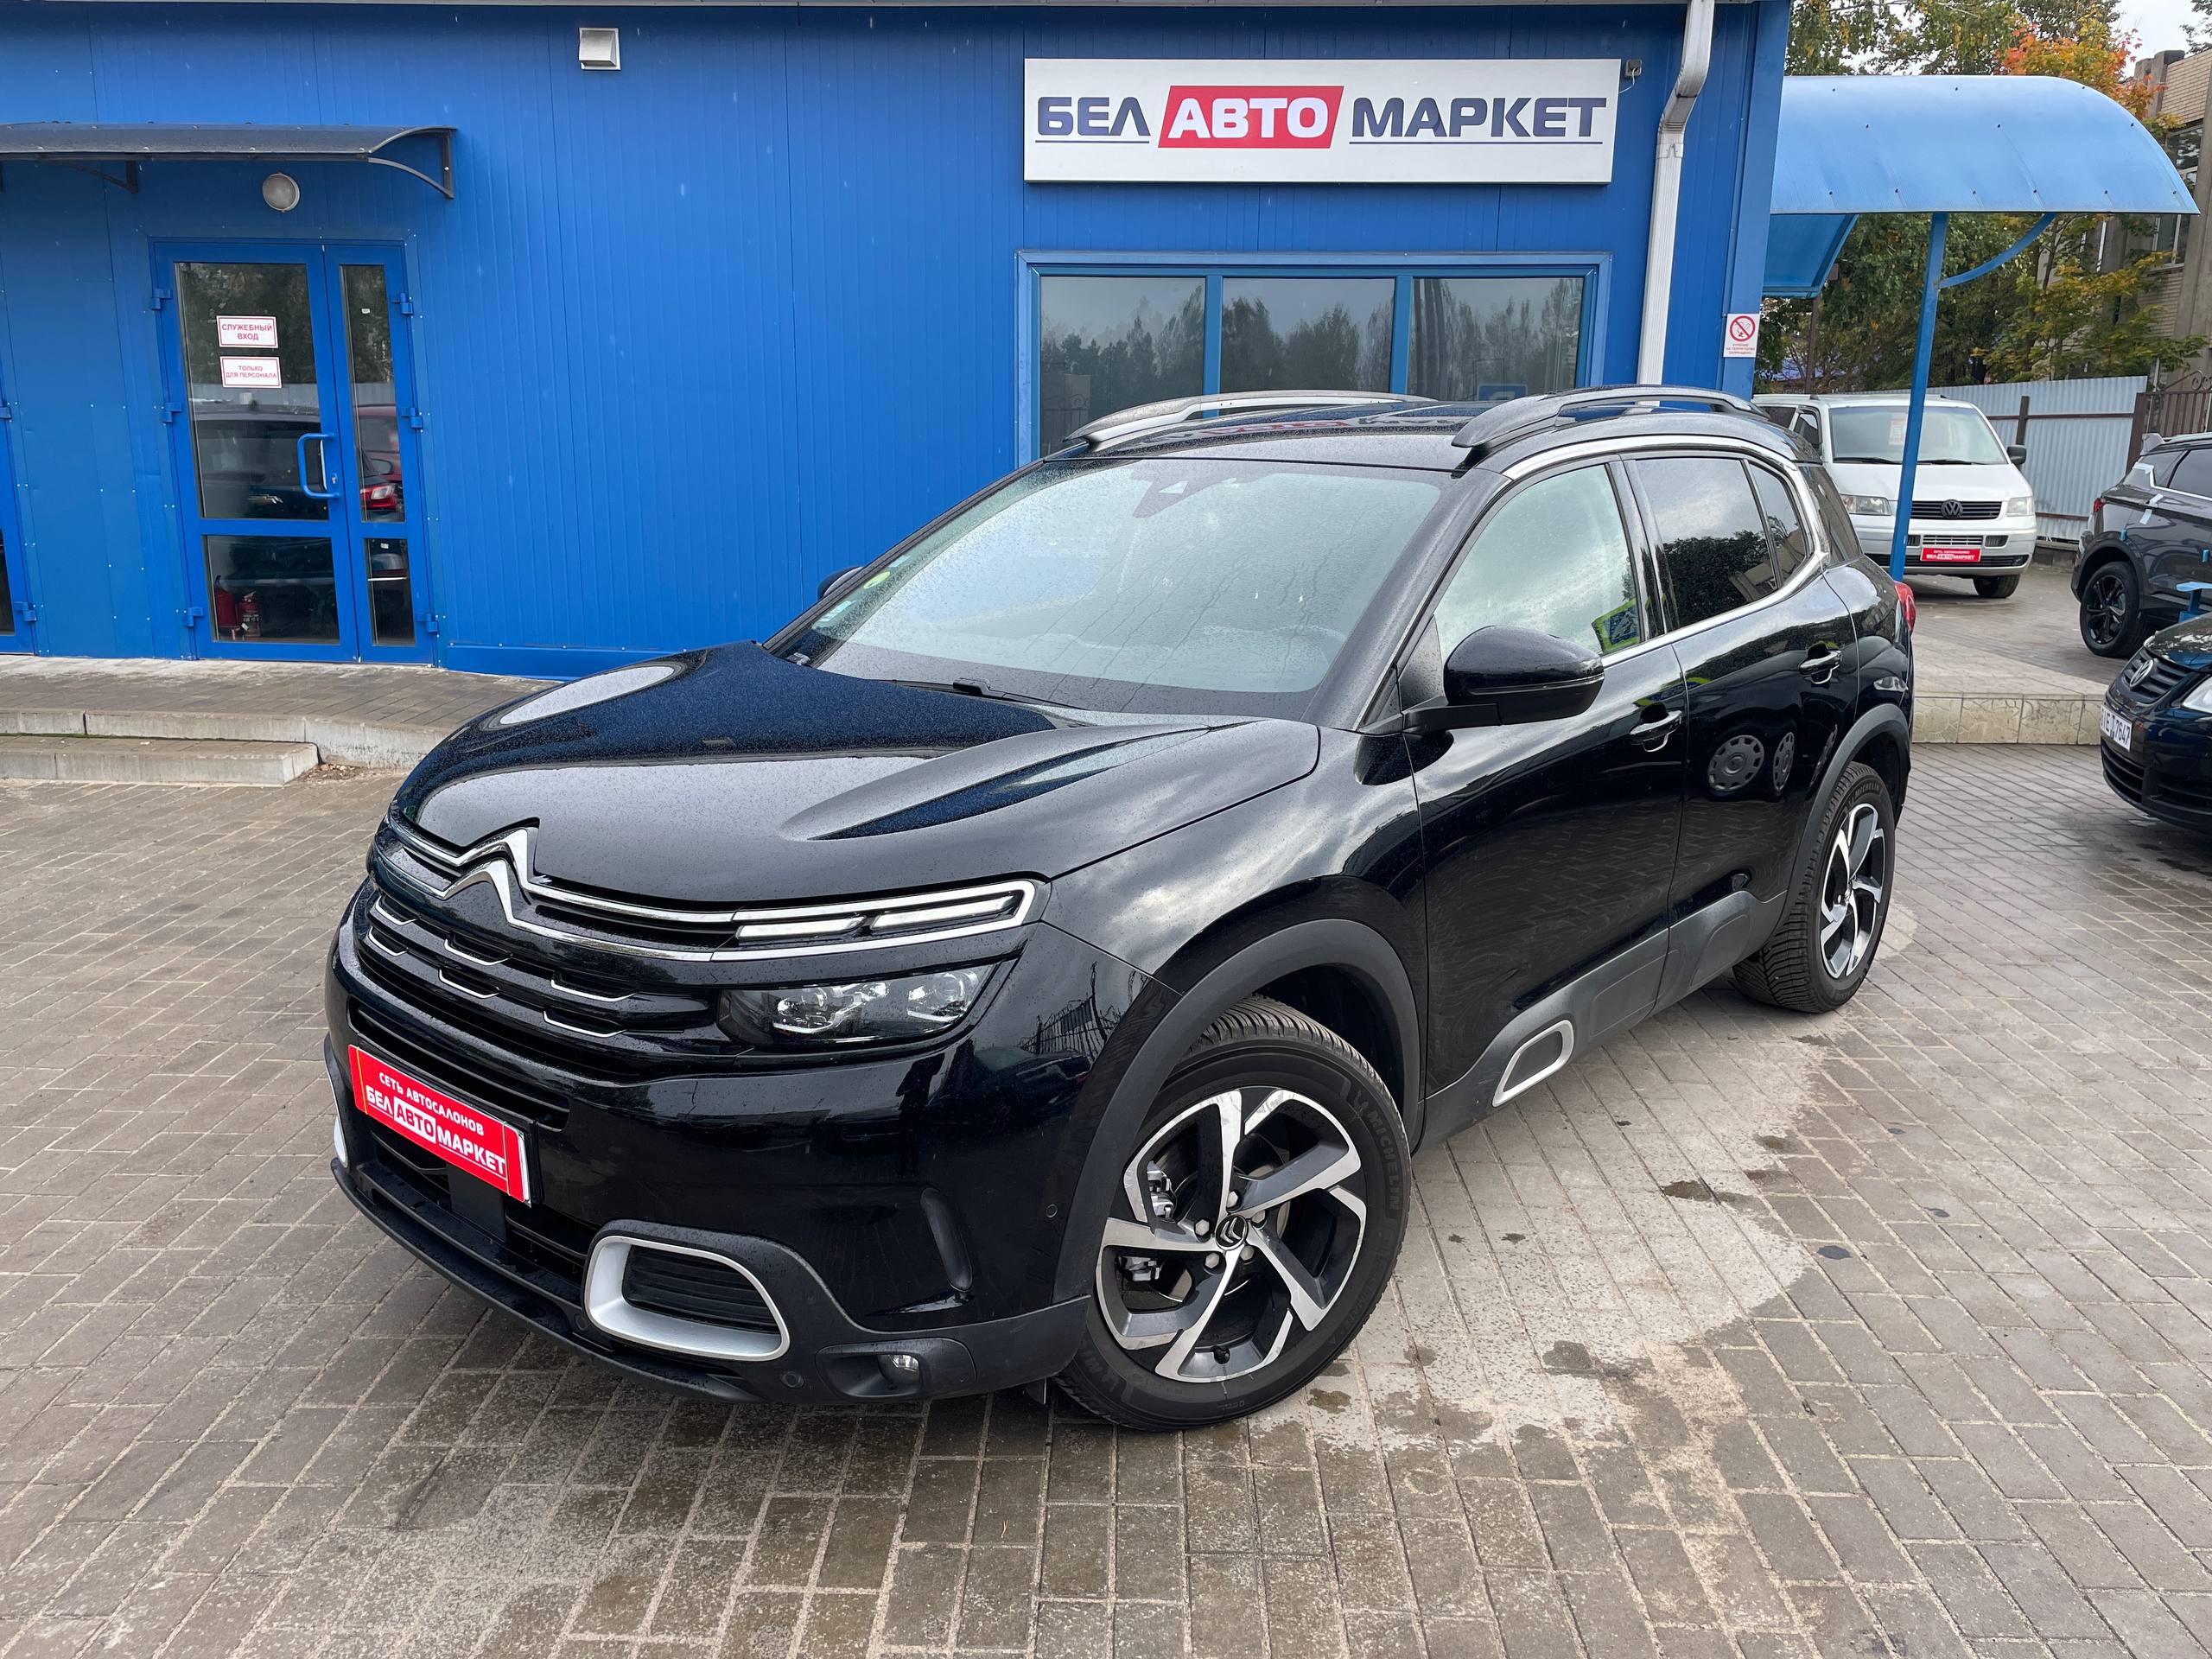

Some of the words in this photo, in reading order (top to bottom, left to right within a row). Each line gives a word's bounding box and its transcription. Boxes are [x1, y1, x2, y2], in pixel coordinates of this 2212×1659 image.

[1037, 97, 1150, 137] БЕЛ
[1168, 97, 1329, 139] АВТО
[1352, 97, 1607, 138] МАРКЕТ
[221, 323, 272, 332] СЛУЖЕБНЫЙ
[237, 333, 259, 341] ВХОД
[365, 1084, 392, 1115] БЕЛ
[397, 1099, 435, 1137] АВТО
[437, 1126, 505, 1175] МАРКЕТ
[379, 1072, 404, 1095] СЕТЬ
[406, 1086, 485, 1136] АВТОСАЛОНОВ
[1367, 1109, 1400, 1211] MICHELIN
